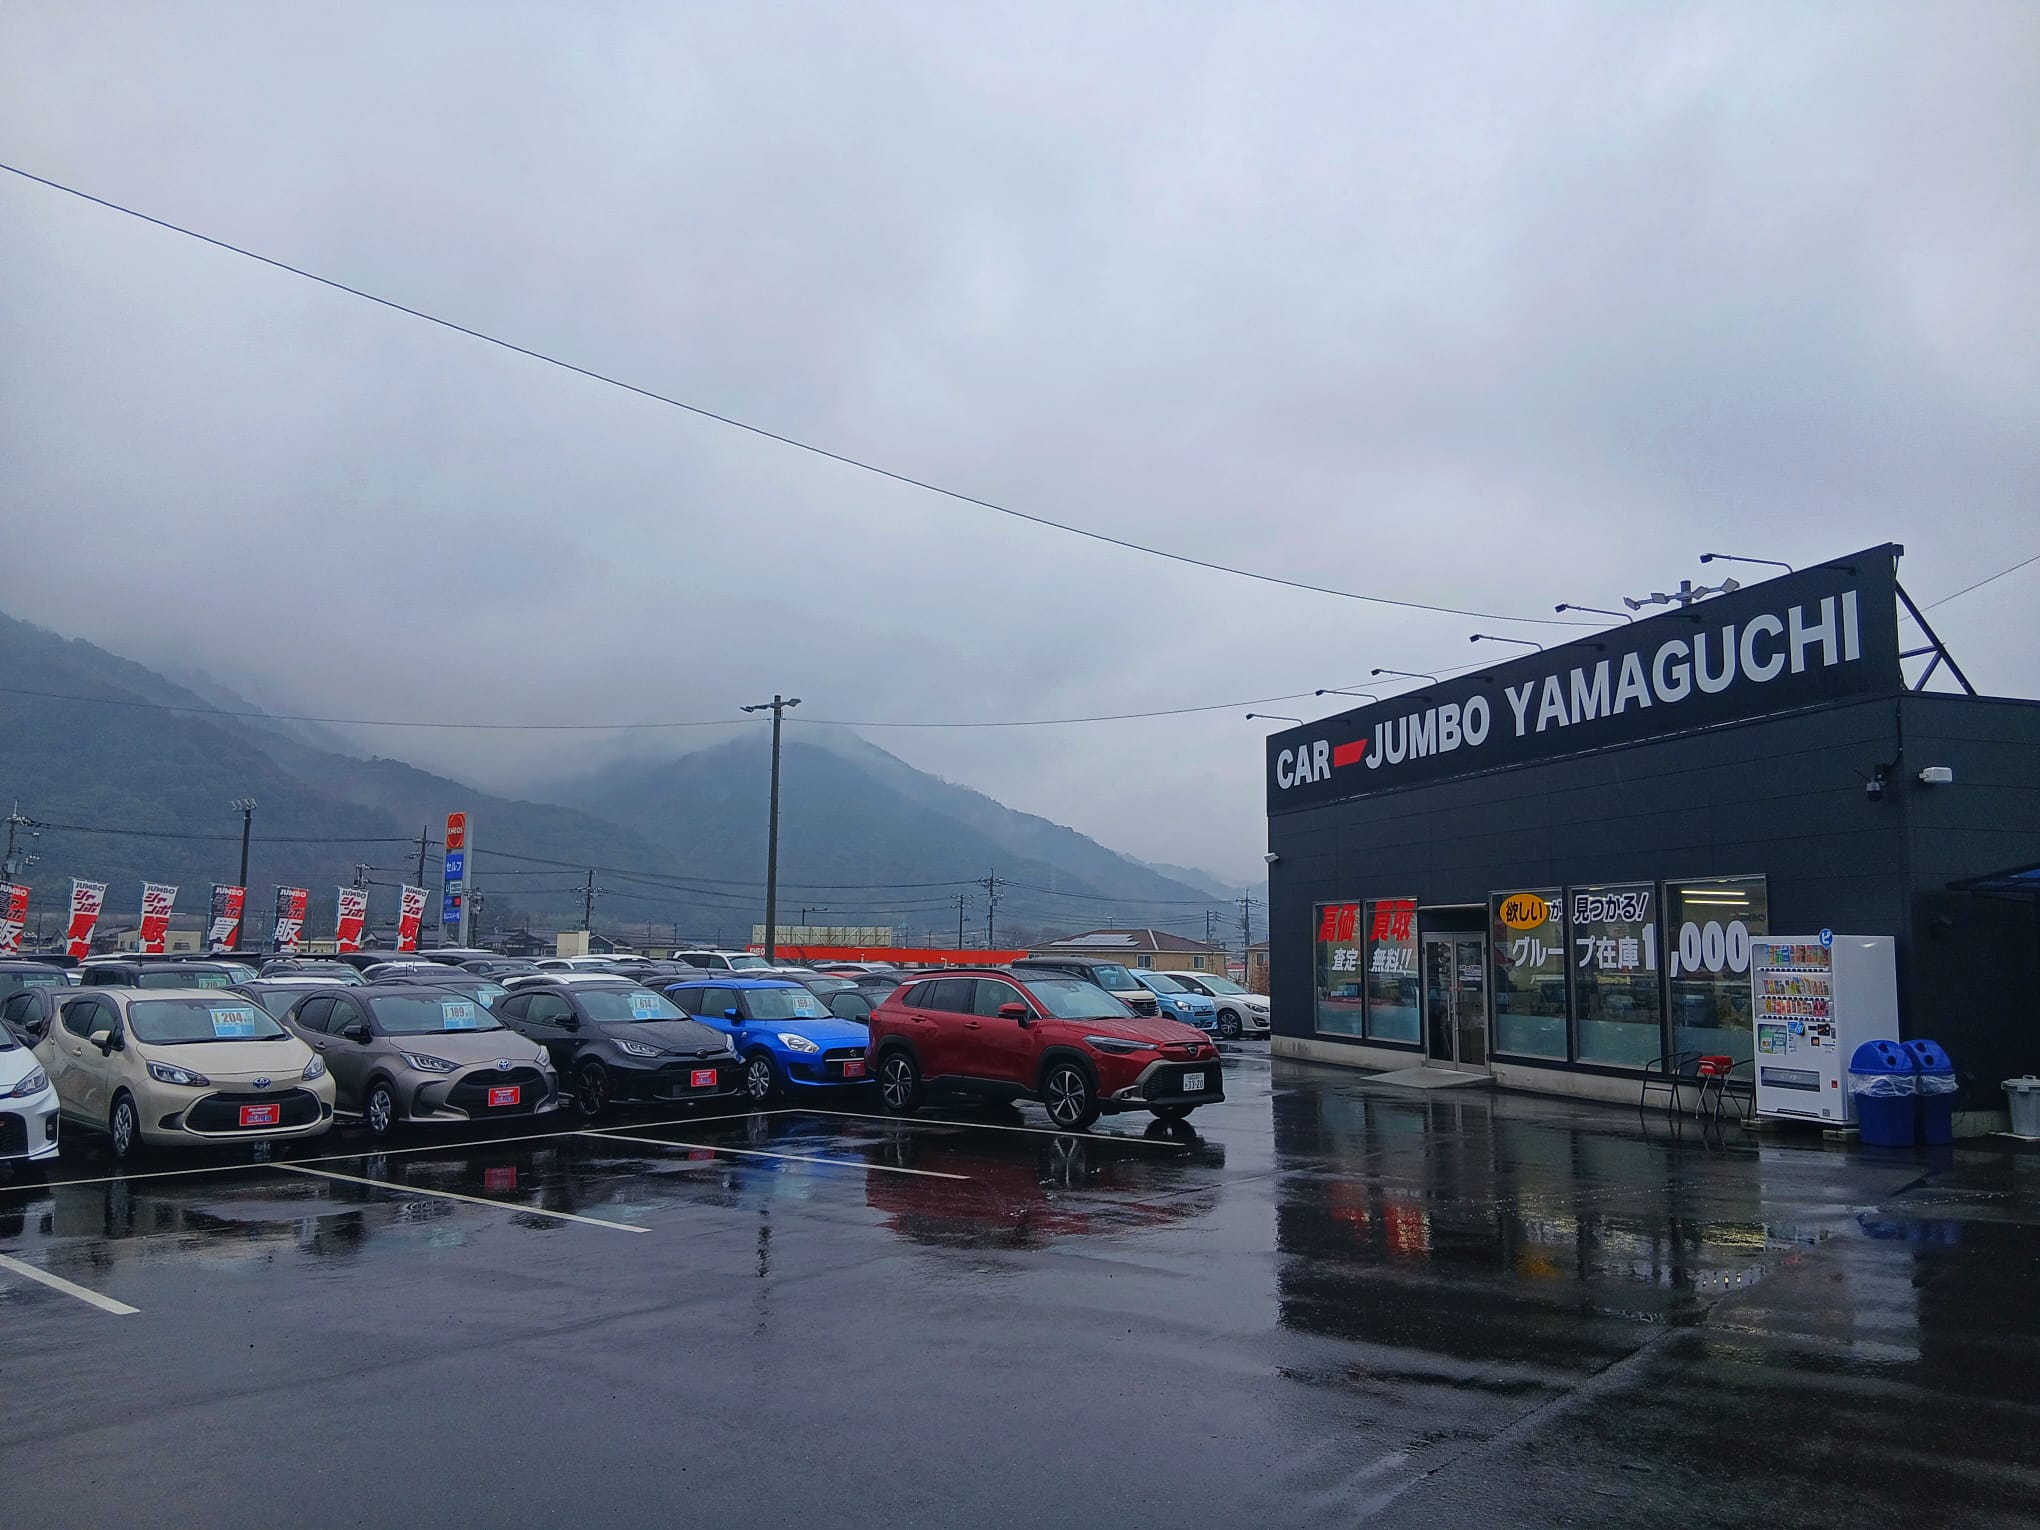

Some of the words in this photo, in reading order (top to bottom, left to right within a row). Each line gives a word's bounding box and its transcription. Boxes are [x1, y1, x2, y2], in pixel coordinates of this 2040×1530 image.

[1277, 740, 1331, 790] CAR
[1365, 695, 1490, 770] JUMBO
[1504, 589, 1861, 737] YAMAGUCHI
[446, 861, 462, 872] セルフ
[76, 882, 105, 892] JUMBO
[147, 885, 175, 894] JUMBO
[215, 887, 244, 897] JUMBO
[405, 887, 427, 897] JUMBO
[280, 888, 307, 898] JUMBO
[342, 890, 367, 899] JUMBO
[1505, 901, 1543, 923] 欲しい
[450, 1007, 465, 1017] 189
[221, 1012, 242, 1023] 204
